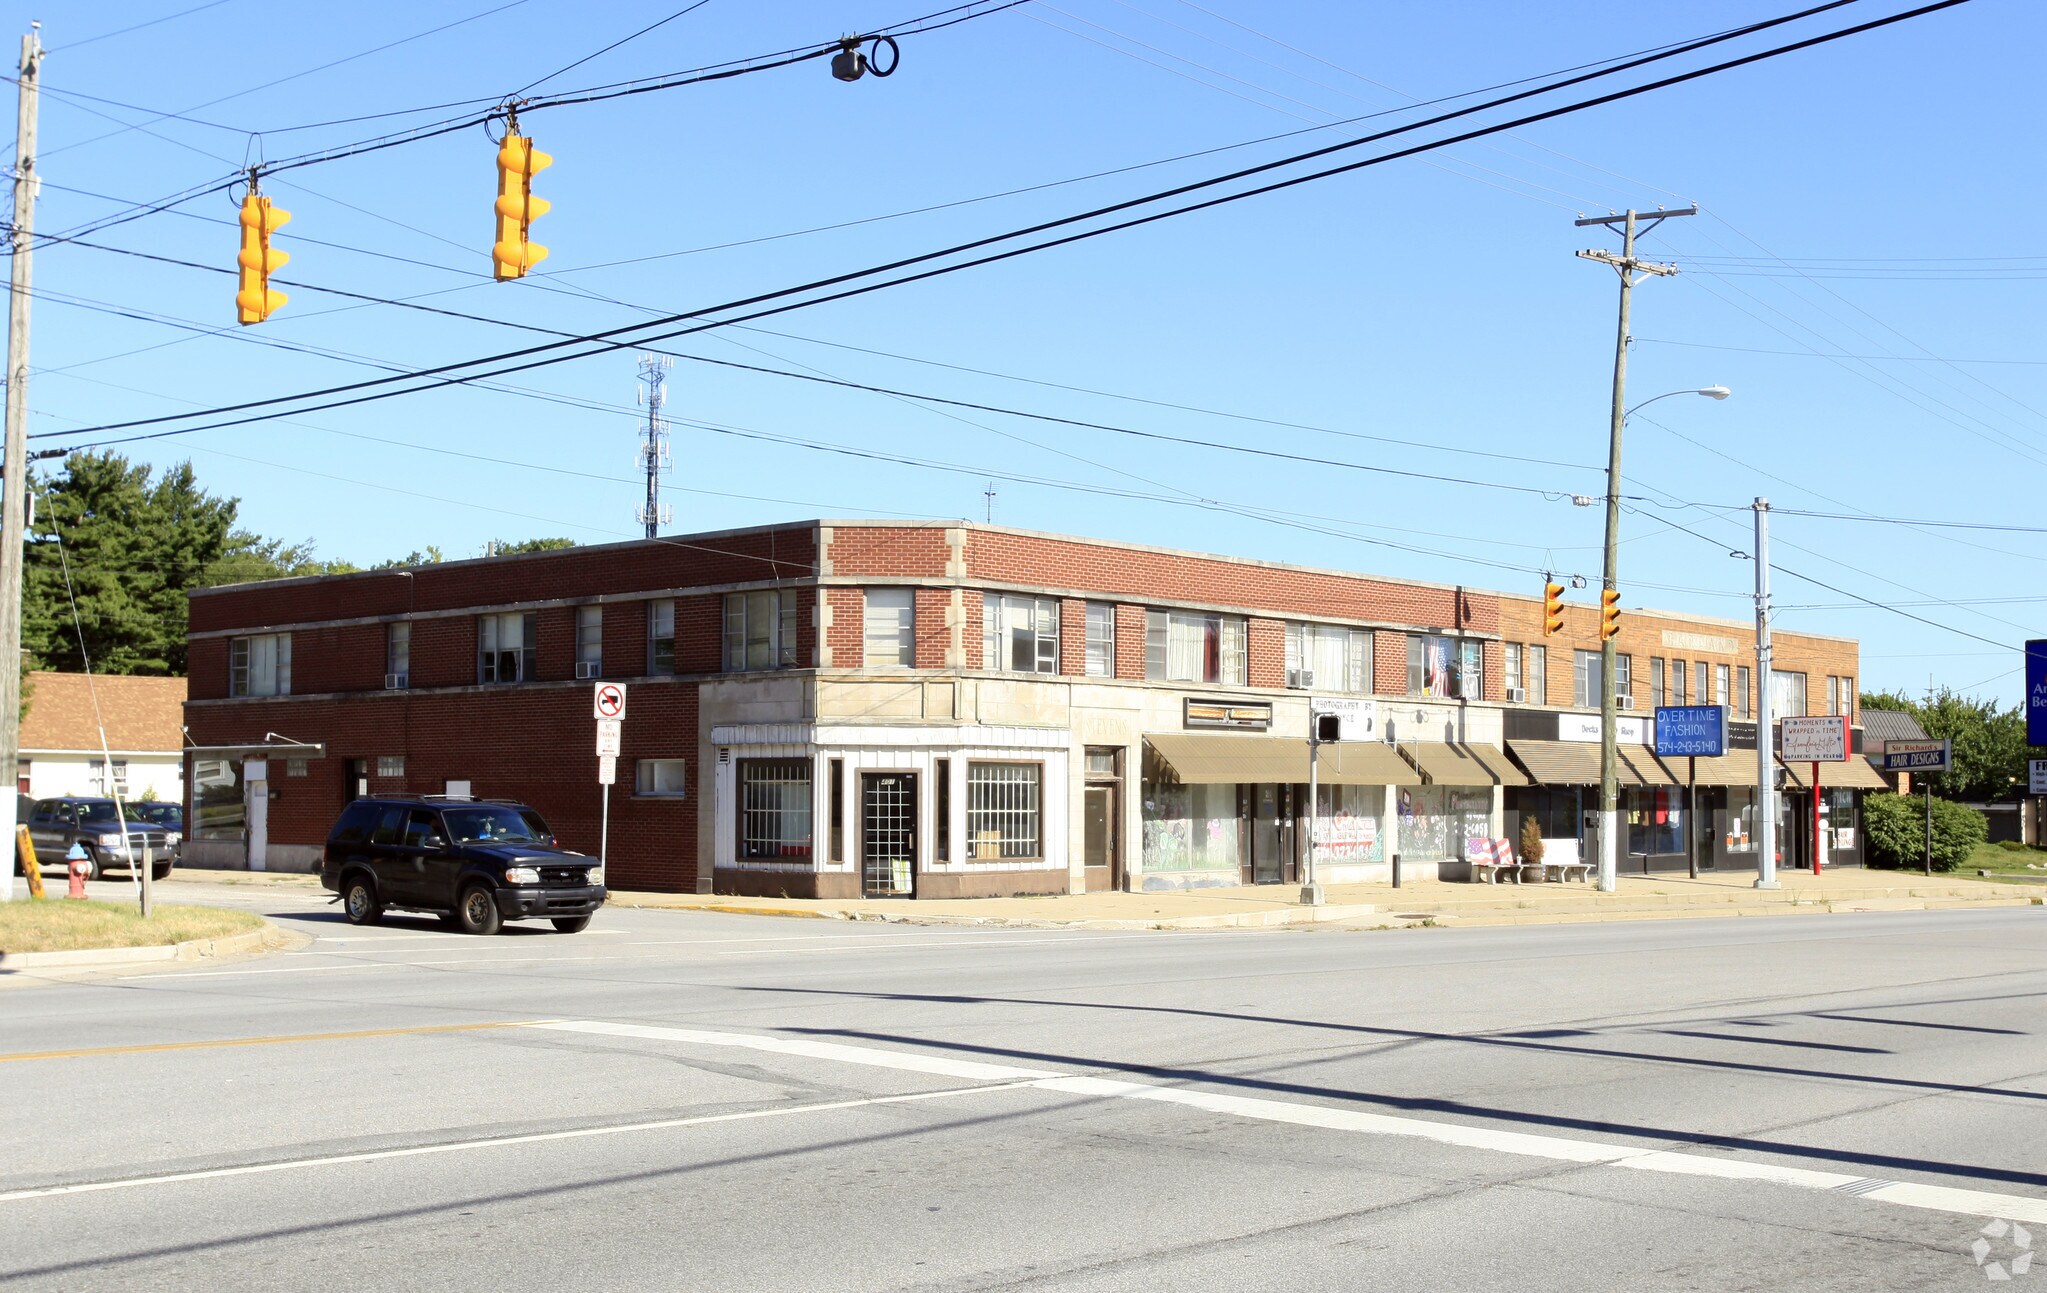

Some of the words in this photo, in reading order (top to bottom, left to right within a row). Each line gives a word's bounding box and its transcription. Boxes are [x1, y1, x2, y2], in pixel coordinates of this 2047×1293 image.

[1657, 710, 1685, 723] OVER
[1688, 709, 1716, 721] TIME
[1665, 724, 1706, 737] FASHION
[1657, 740, 1717, 753] 574-243-5140
[1891, 754, 1908, 767] HAIR
[1910, 751, 1940, 766] DESIGNS
